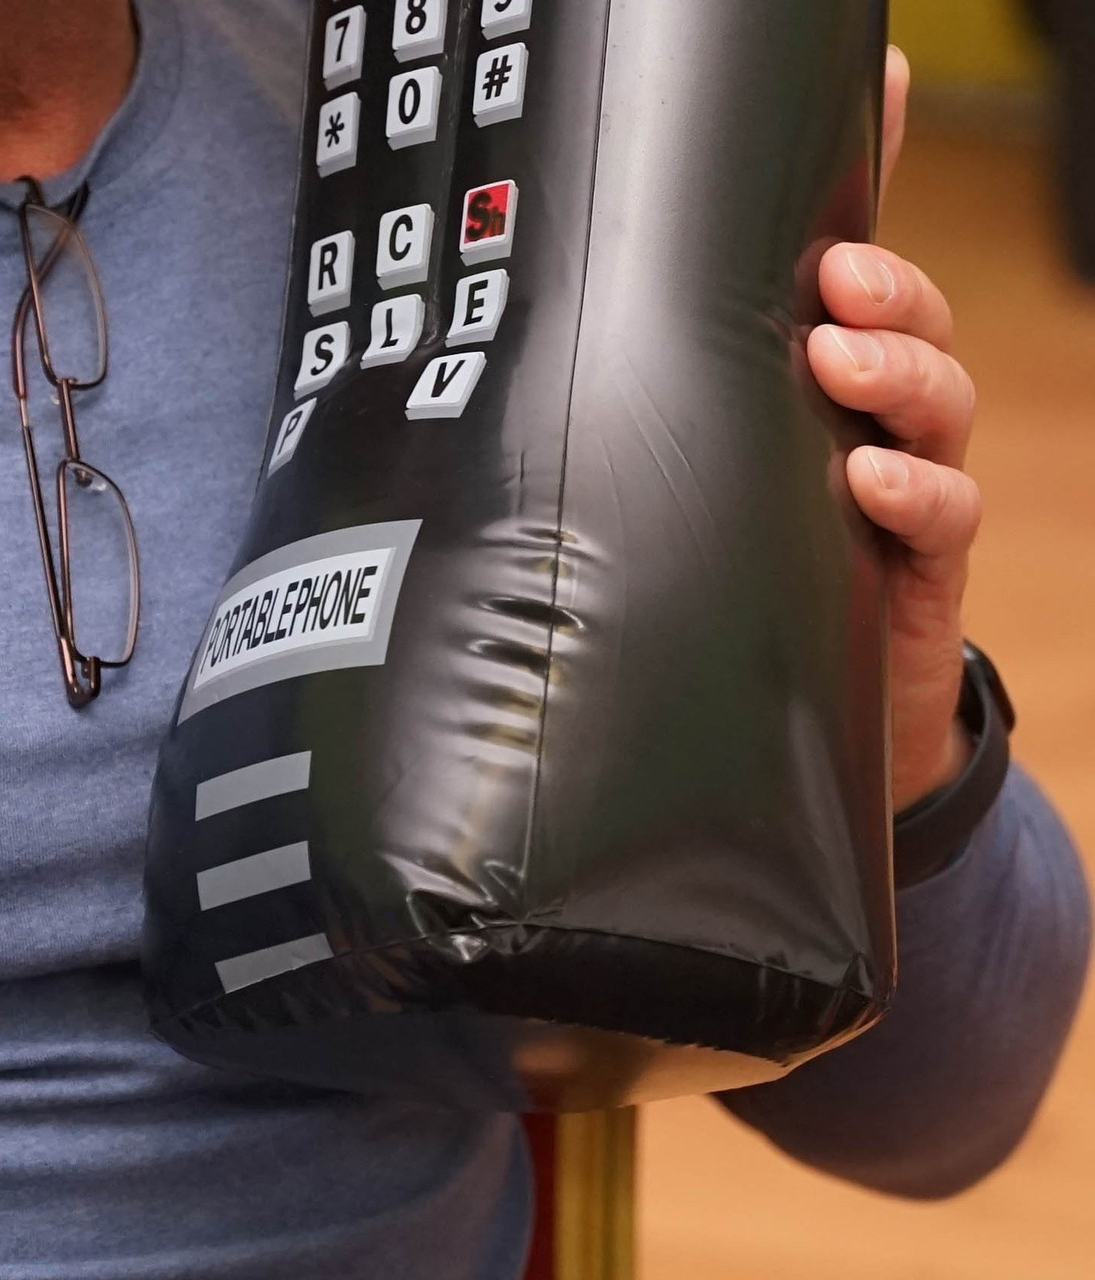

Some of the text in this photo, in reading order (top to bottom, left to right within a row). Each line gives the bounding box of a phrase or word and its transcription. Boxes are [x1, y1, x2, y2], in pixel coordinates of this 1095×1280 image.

[334, 15, 351, 63] 7
[398, 78, 421, 125] 0
[481, 54, 513, 101] #
[317, 241, 339, 291] R
[388, 213, 414, 262] C
[310, 279, 489, 377] S L E
[277, 359, 466, 457] P V
[199, 564, 380, 675] PORTABLEPHONE
